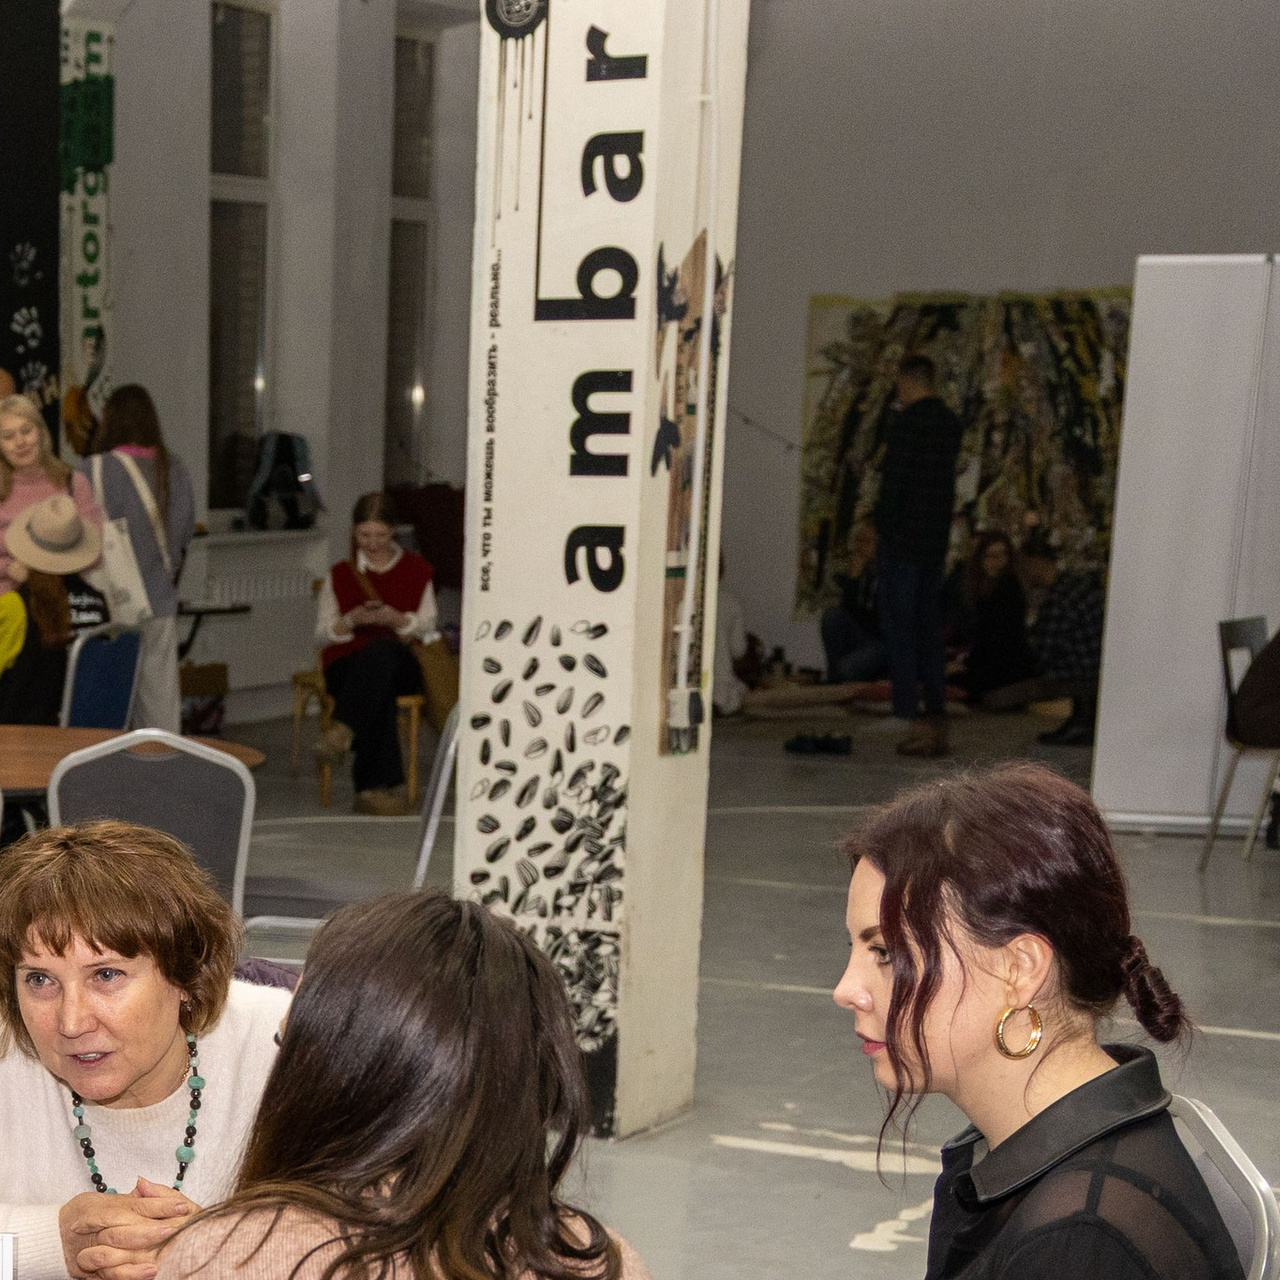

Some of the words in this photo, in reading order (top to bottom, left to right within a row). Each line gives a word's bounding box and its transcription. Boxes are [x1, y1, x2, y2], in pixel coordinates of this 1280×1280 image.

[534, 24, 648, 592] ambar
[483, 344, 499, 434] вообразить
[483, 437, 495, 503] можешь
[481, 506, 493, 528] ты
[481, 531, 493, 558] что
